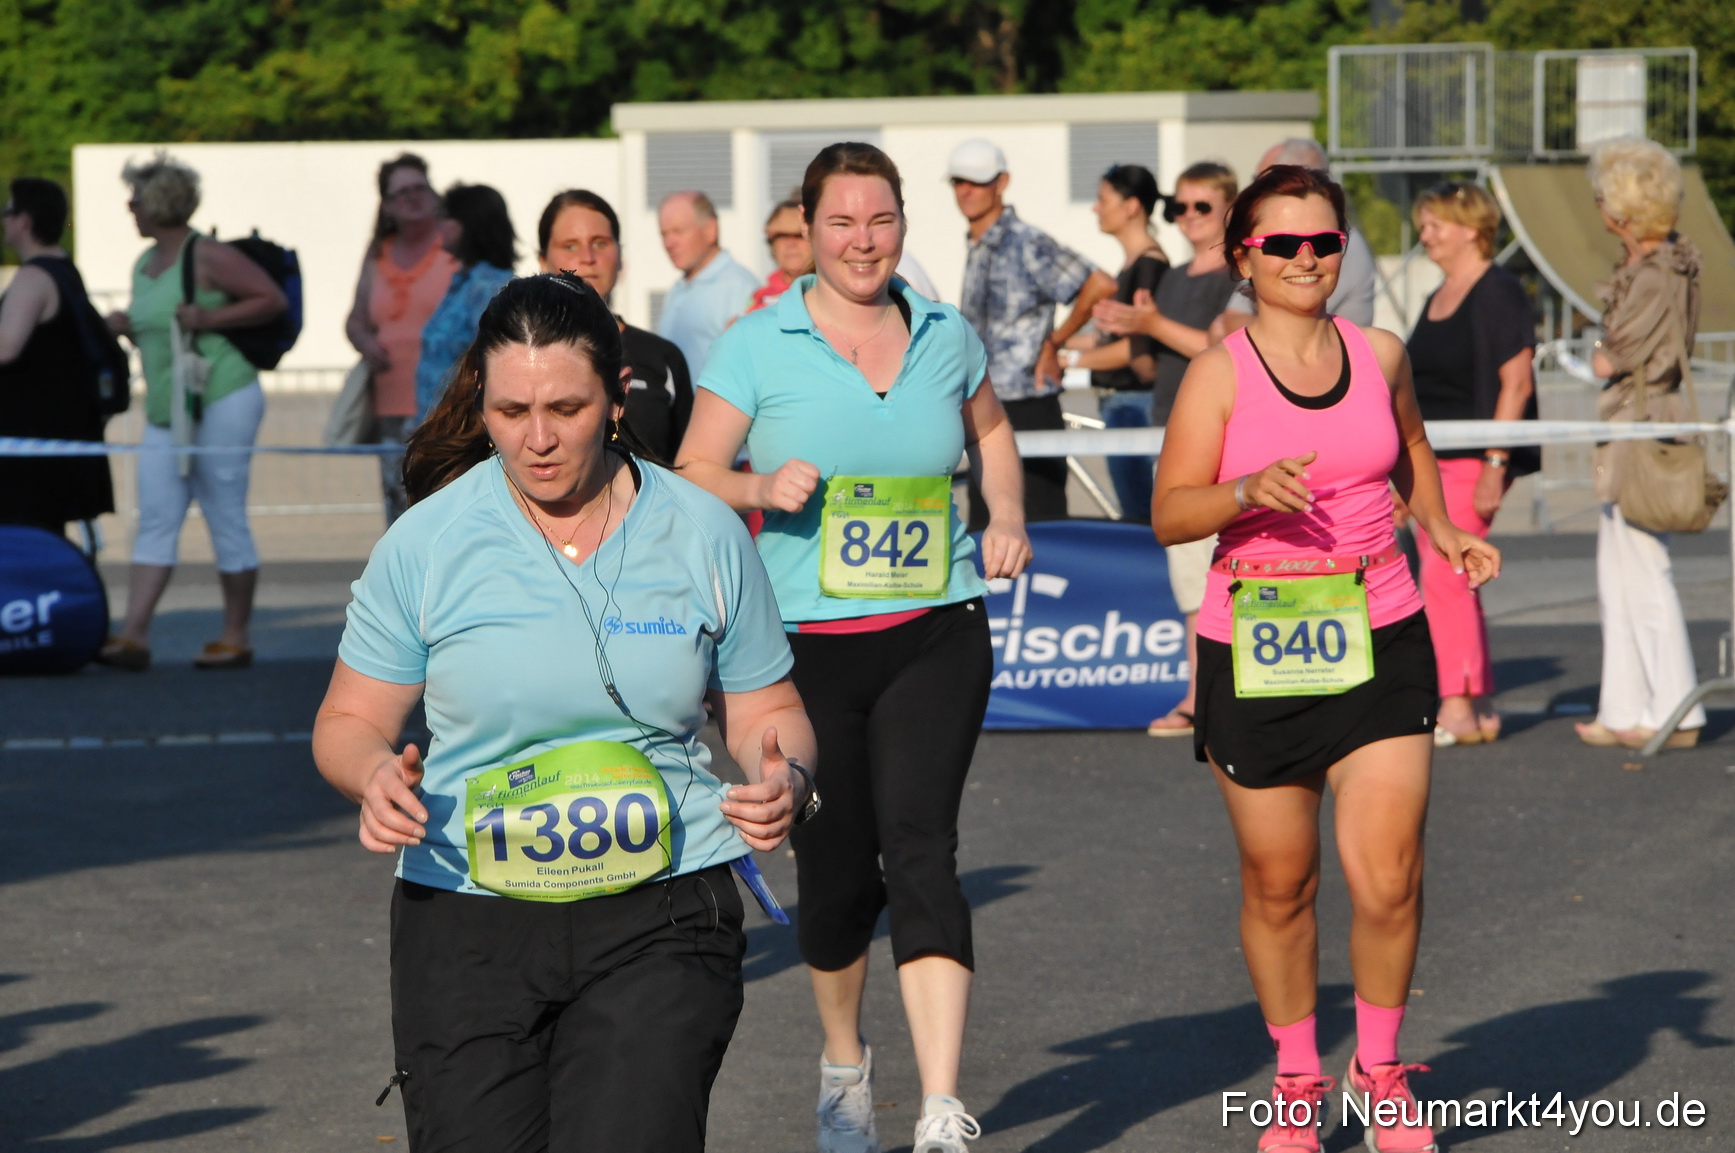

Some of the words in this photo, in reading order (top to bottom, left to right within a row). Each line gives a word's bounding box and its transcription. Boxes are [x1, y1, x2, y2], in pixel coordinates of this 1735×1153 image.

[840, 520, 930, 568] 842
[625, 616, 687, 635] sumida
[987, 610, 1186, 665] Fische
[1252, 619, 1347, 666] 840
[990, 661, 1192, 690] AUTOMOBILE
[497, 770, 561, 798] firmenlauf
[474, 793, 659, 863] 1380
[505, 879, 541, 888] Sumida
[543, 877, 604, 890] Components
[606, 871, 637, 882] GmbH
[537, 867, 570, 876] Eileen
[571, 862, 604, 875] Pukall
